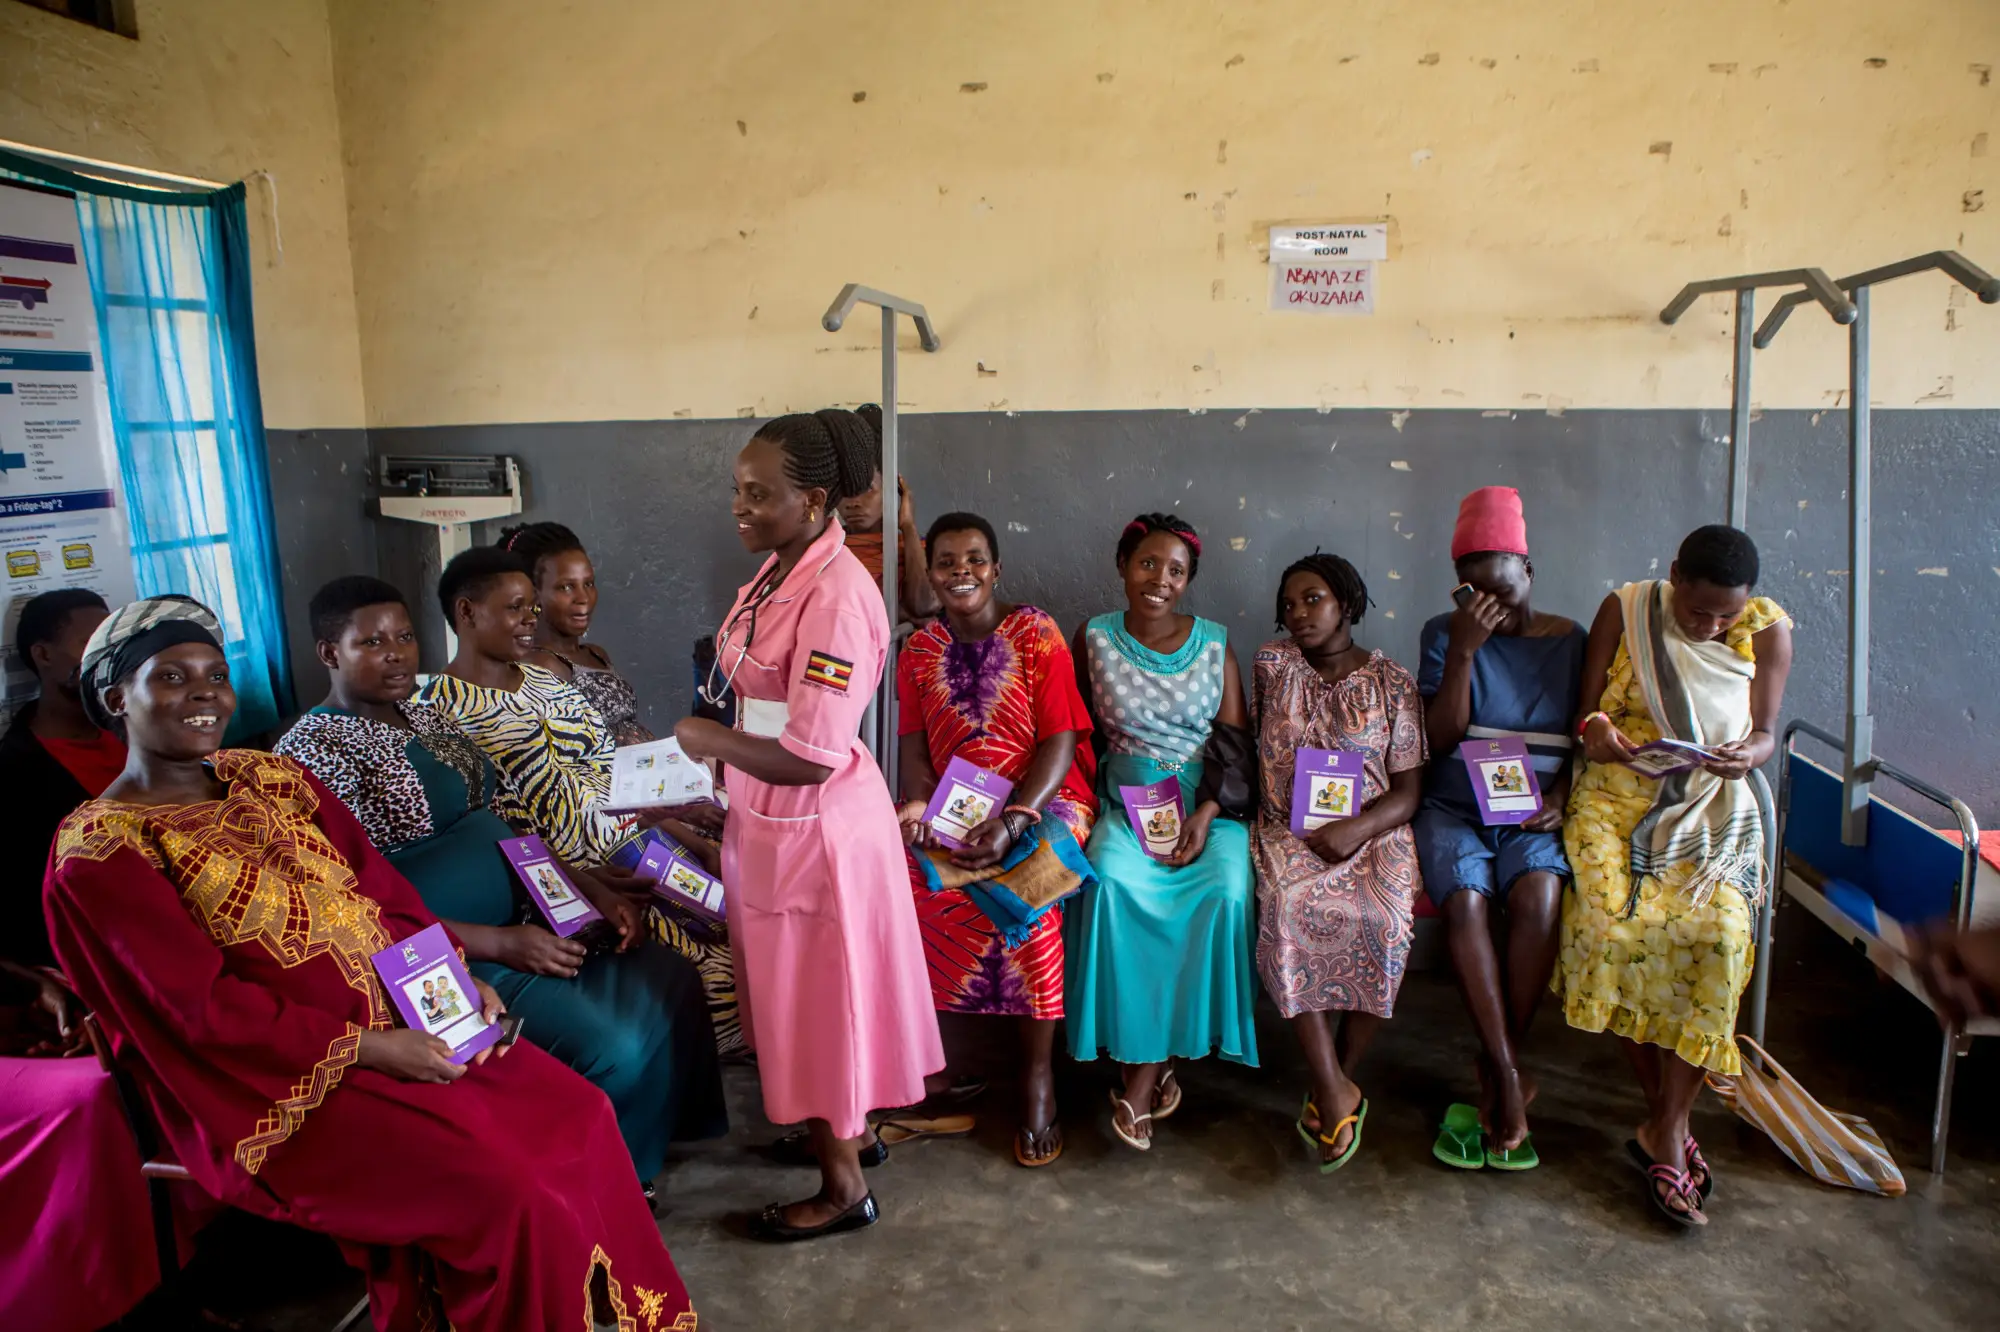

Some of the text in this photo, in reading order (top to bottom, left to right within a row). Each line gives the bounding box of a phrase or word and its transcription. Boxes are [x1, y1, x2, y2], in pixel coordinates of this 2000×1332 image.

[1295, 230, 1367, 240] POST-NATAL
[1314, 247, 1348, 256] ROOM
[1289, 290, 1365, 305] OKUZAALA
[7, 504, 13, 512] a
[425, 509, 466, 517] DETECTO
